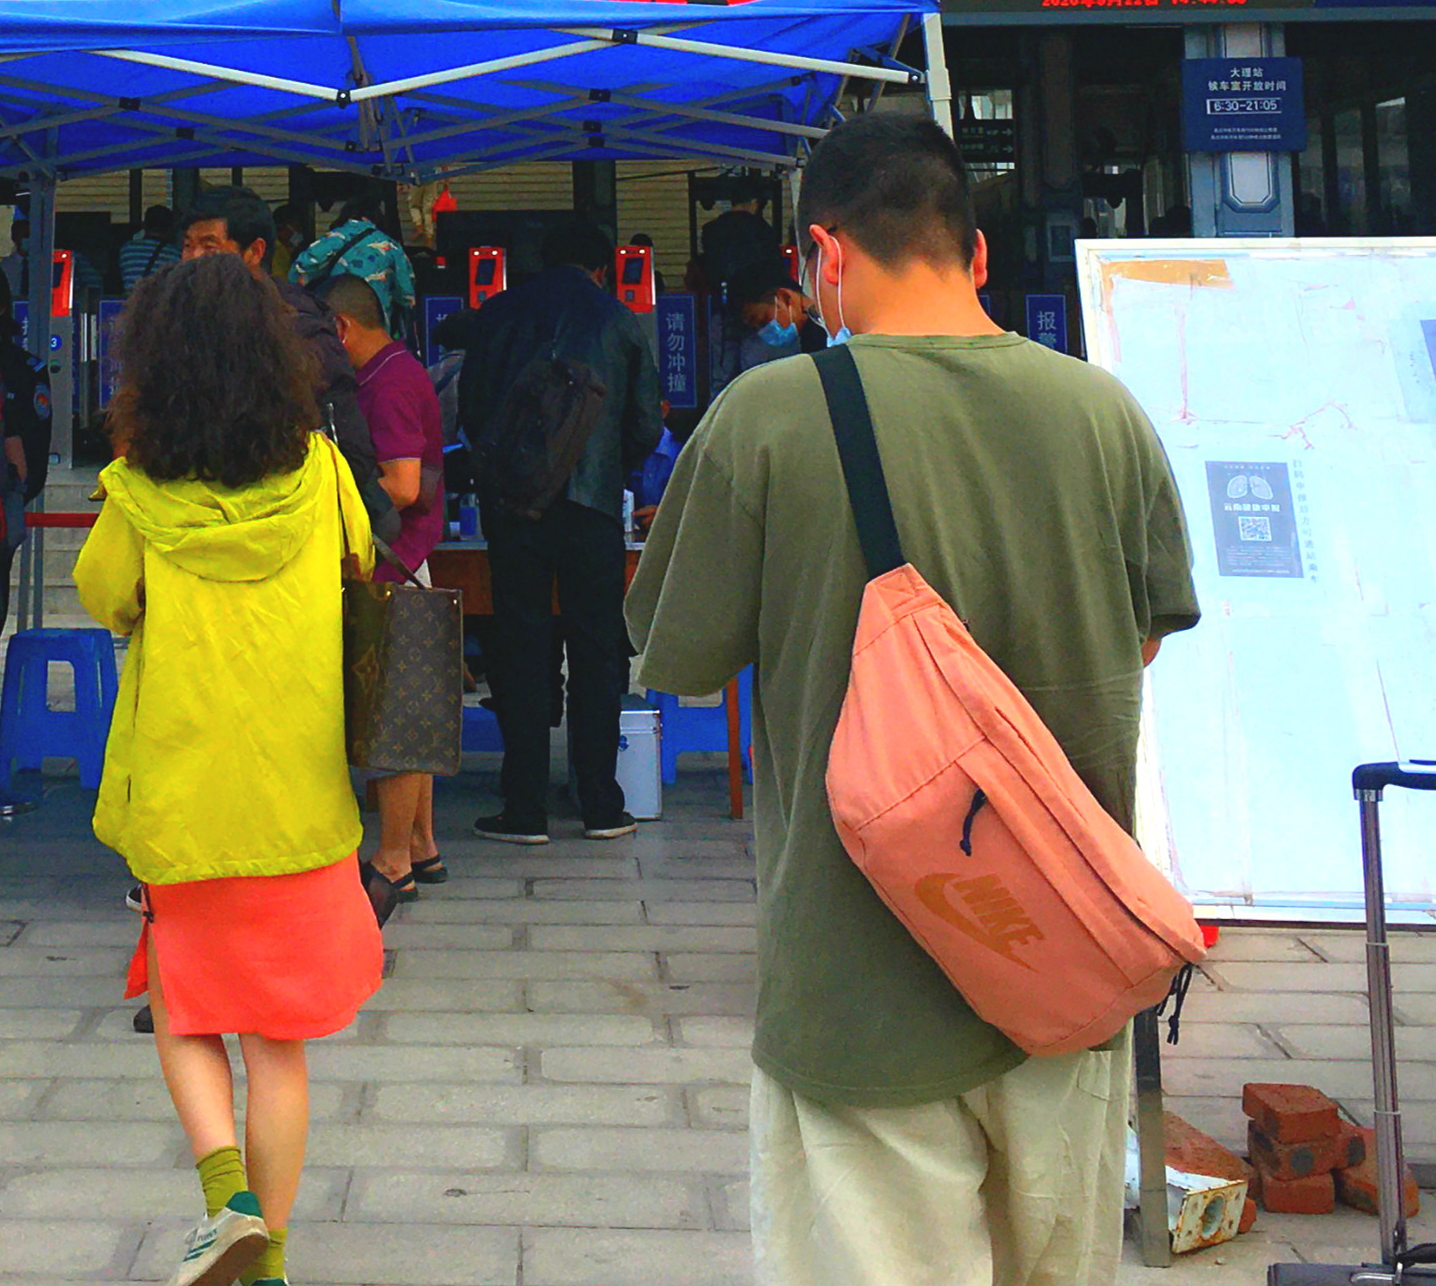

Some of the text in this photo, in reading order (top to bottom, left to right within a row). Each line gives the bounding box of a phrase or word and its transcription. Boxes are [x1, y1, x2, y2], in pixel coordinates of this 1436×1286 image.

[1230, 67, 1264, 78] 大理站
[1213, 99, 1278, 112] 6:30-21:05
[50, 337, 58, 348] 3
[666, 312, 686, 392] 请勿冲撞
[951, 873, 1044, 947] NIKE
